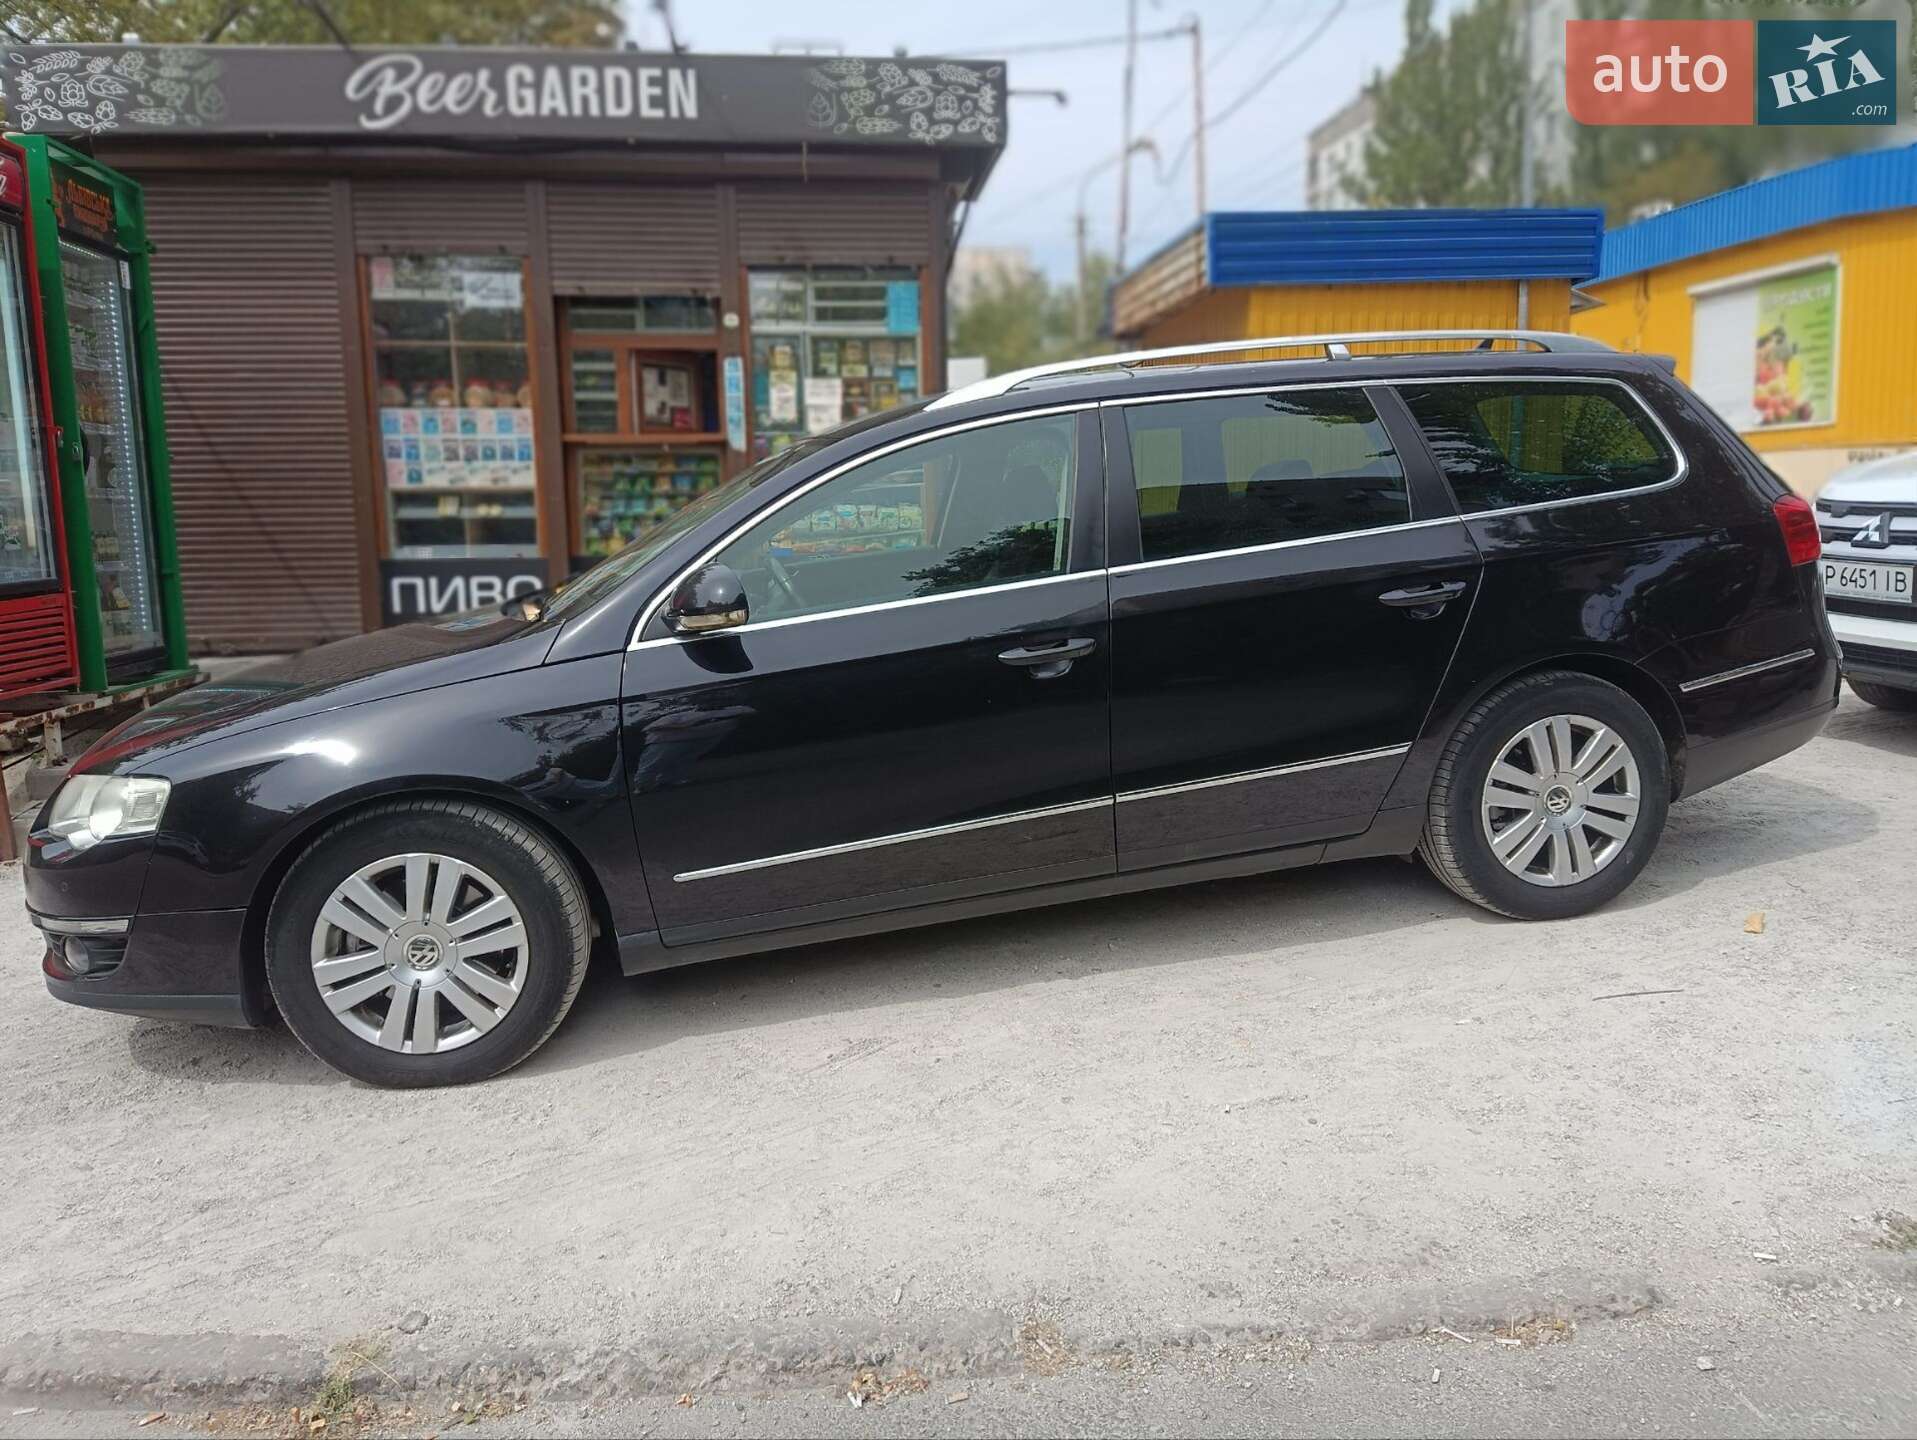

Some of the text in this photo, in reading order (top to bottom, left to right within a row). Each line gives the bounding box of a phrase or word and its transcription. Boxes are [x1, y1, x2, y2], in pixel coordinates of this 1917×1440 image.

[345, 52, 699, 130] Beer GARDEN
[1840, 567, 1877, 591] 6451
[1886, 570, 1908, 593] IB
